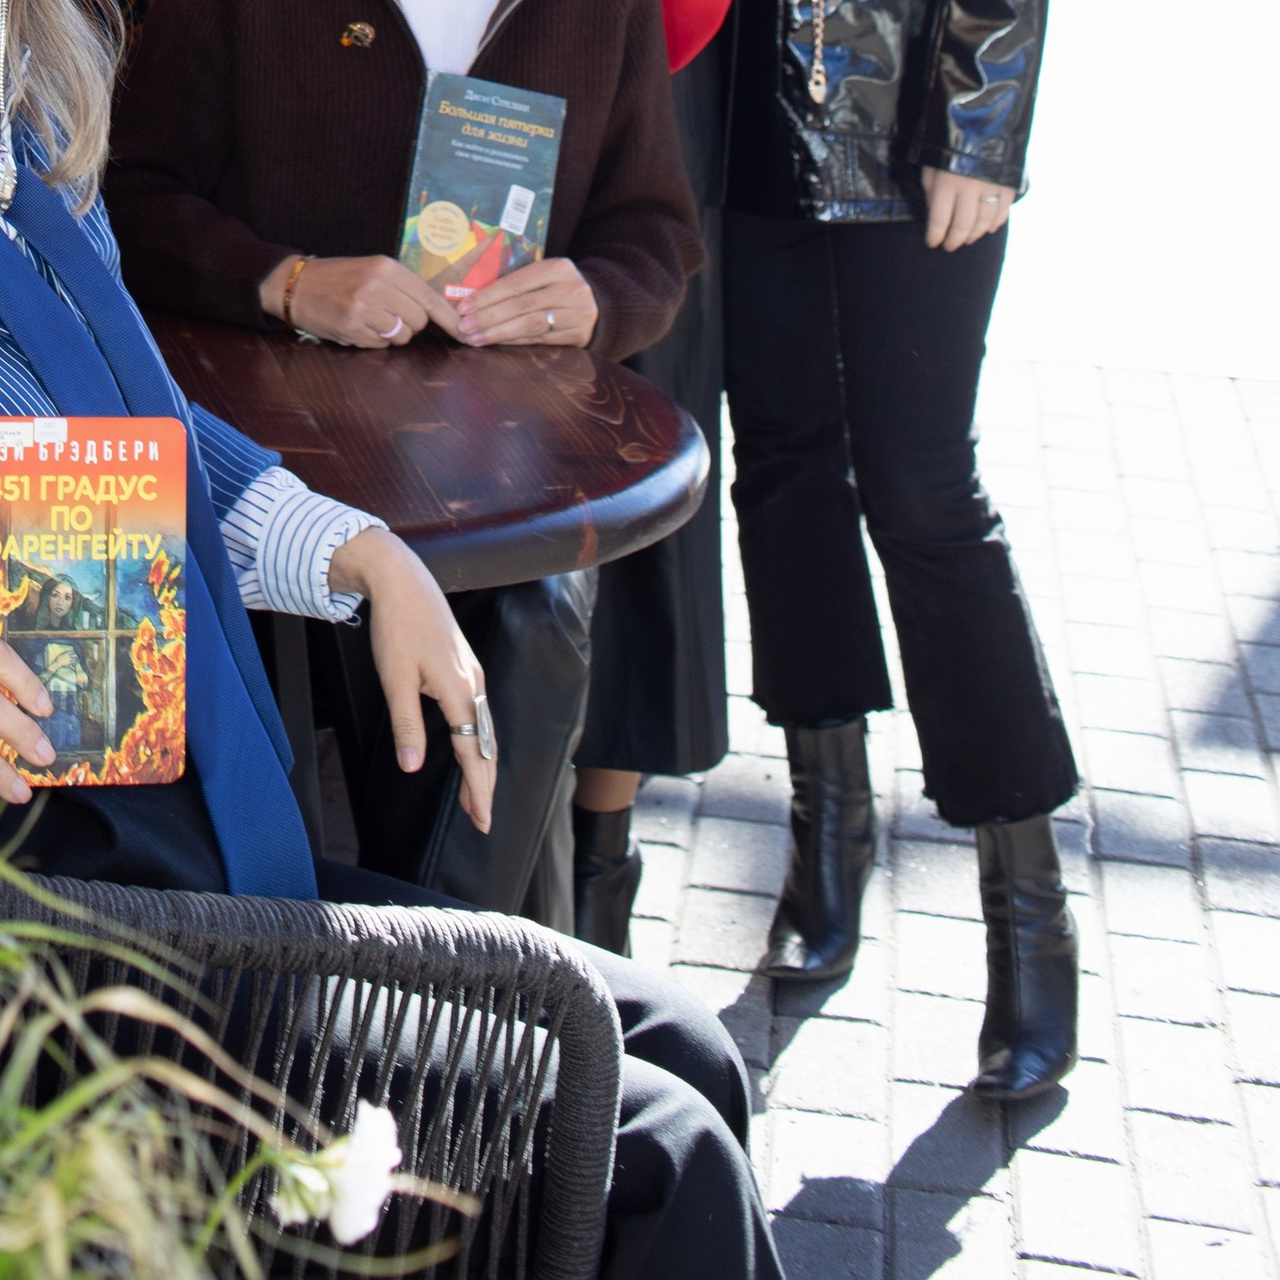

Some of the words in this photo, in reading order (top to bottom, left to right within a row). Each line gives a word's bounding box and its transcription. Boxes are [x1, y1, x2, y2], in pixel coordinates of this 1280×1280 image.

[438, 100, 497, 125] Большая
[461, 122, 486, 138] для
[487, 131, 528, 148] жизни
[39, 440, 159, 464] БРЭДБЕРИ
[40, 474, 158, 505] ГРАДУС
[51, 505, 93, 532] ПО
